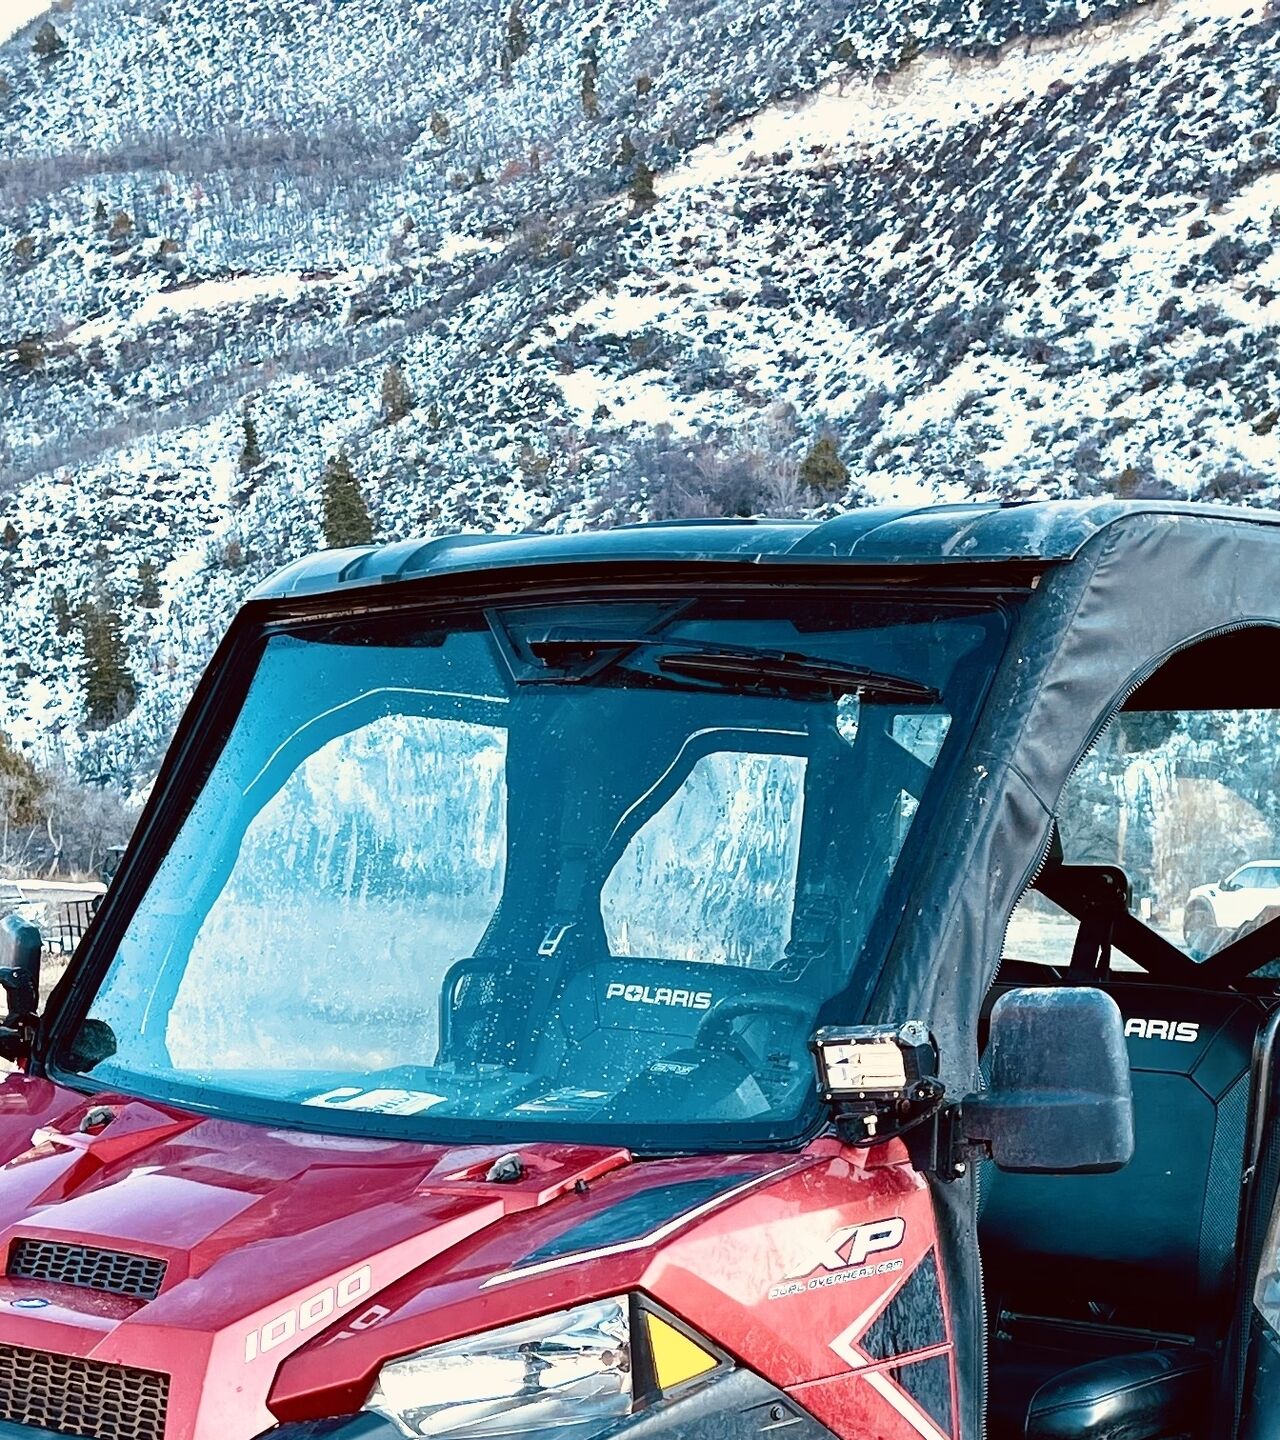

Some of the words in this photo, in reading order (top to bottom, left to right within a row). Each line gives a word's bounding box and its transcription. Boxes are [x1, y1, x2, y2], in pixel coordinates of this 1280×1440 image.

[606, 983, 712, 1010] POLARIS
[1124, 1018, 1200, 1042] ARIS
[784, 1216, 907, 1280] XP
[245, 1264, 372, 1363] 1000
